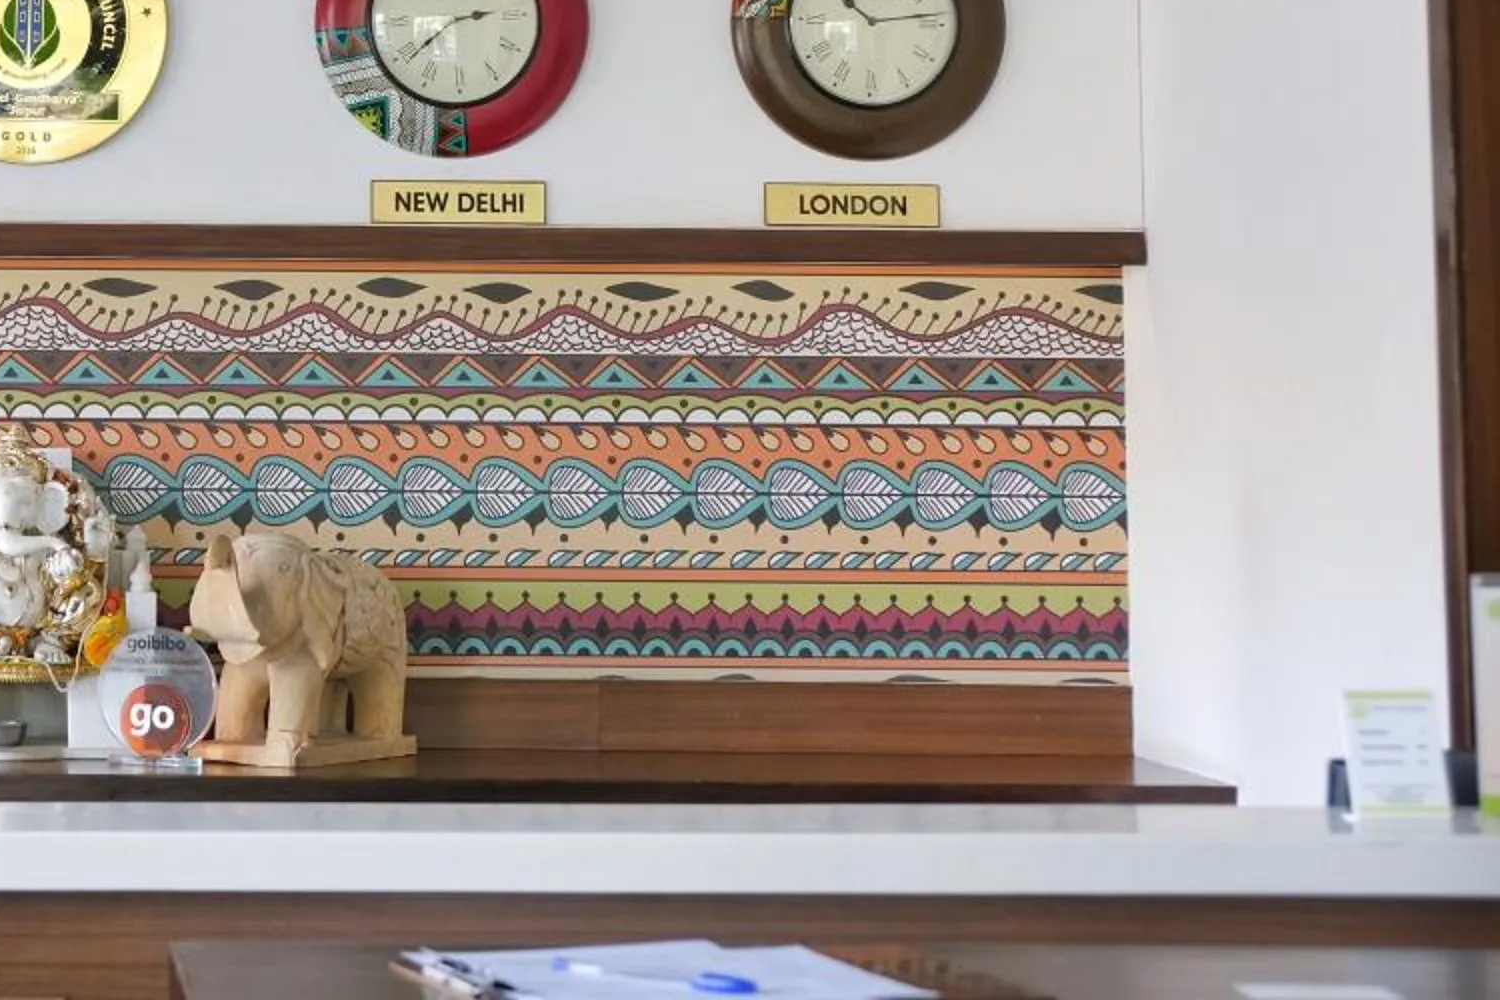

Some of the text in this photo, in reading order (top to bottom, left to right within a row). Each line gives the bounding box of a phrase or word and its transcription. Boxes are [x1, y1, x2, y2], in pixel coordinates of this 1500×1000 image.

[1, 131, 52, 143] GOLD
[394, 191, 525, 214] NEW DELHI
[799, 194, 907, 216] LONDON
[127, 634, 186, 652] goibibo
[130, 703, 174, 737] go
